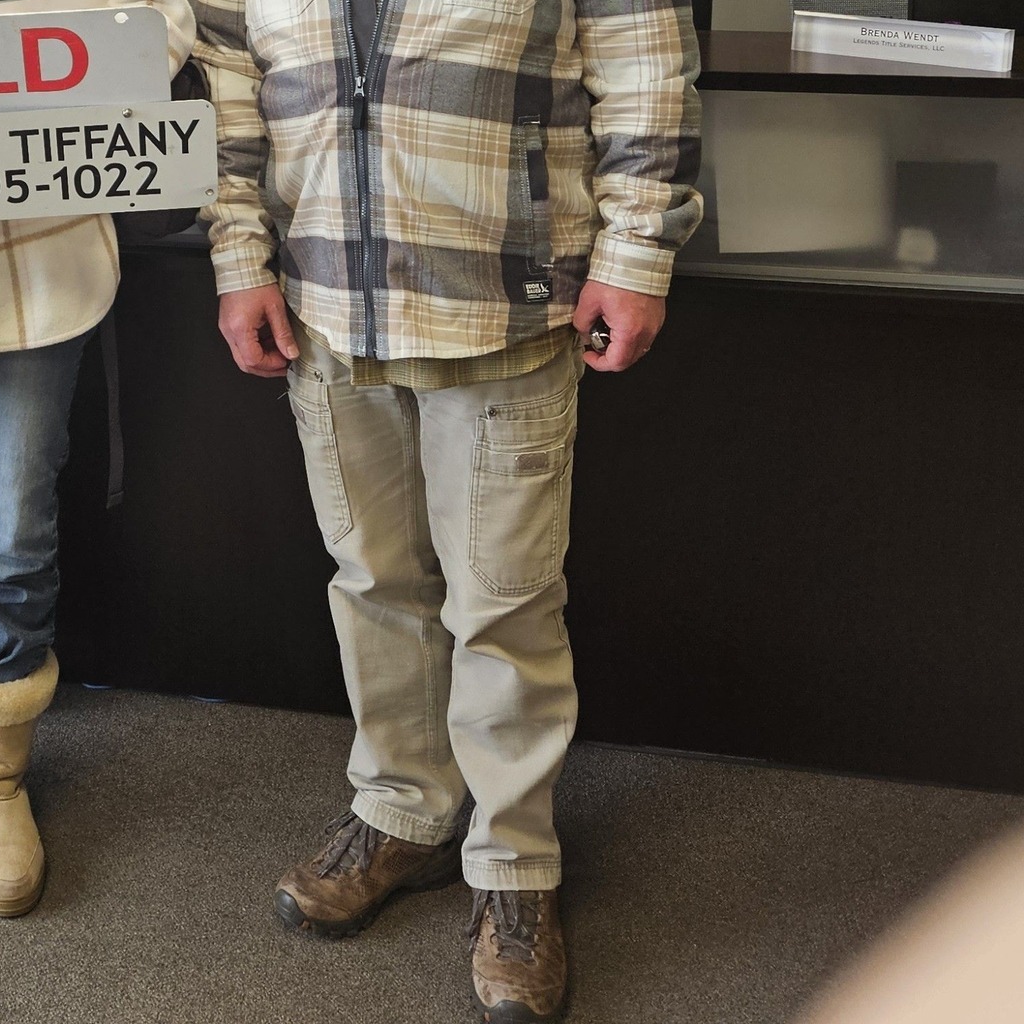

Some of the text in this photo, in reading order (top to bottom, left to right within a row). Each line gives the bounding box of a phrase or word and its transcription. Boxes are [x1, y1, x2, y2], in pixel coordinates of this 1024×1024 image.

[861, 27, 939, 43] BRENDA WENDT
[8, 118, 200, 164] TIFFANY
